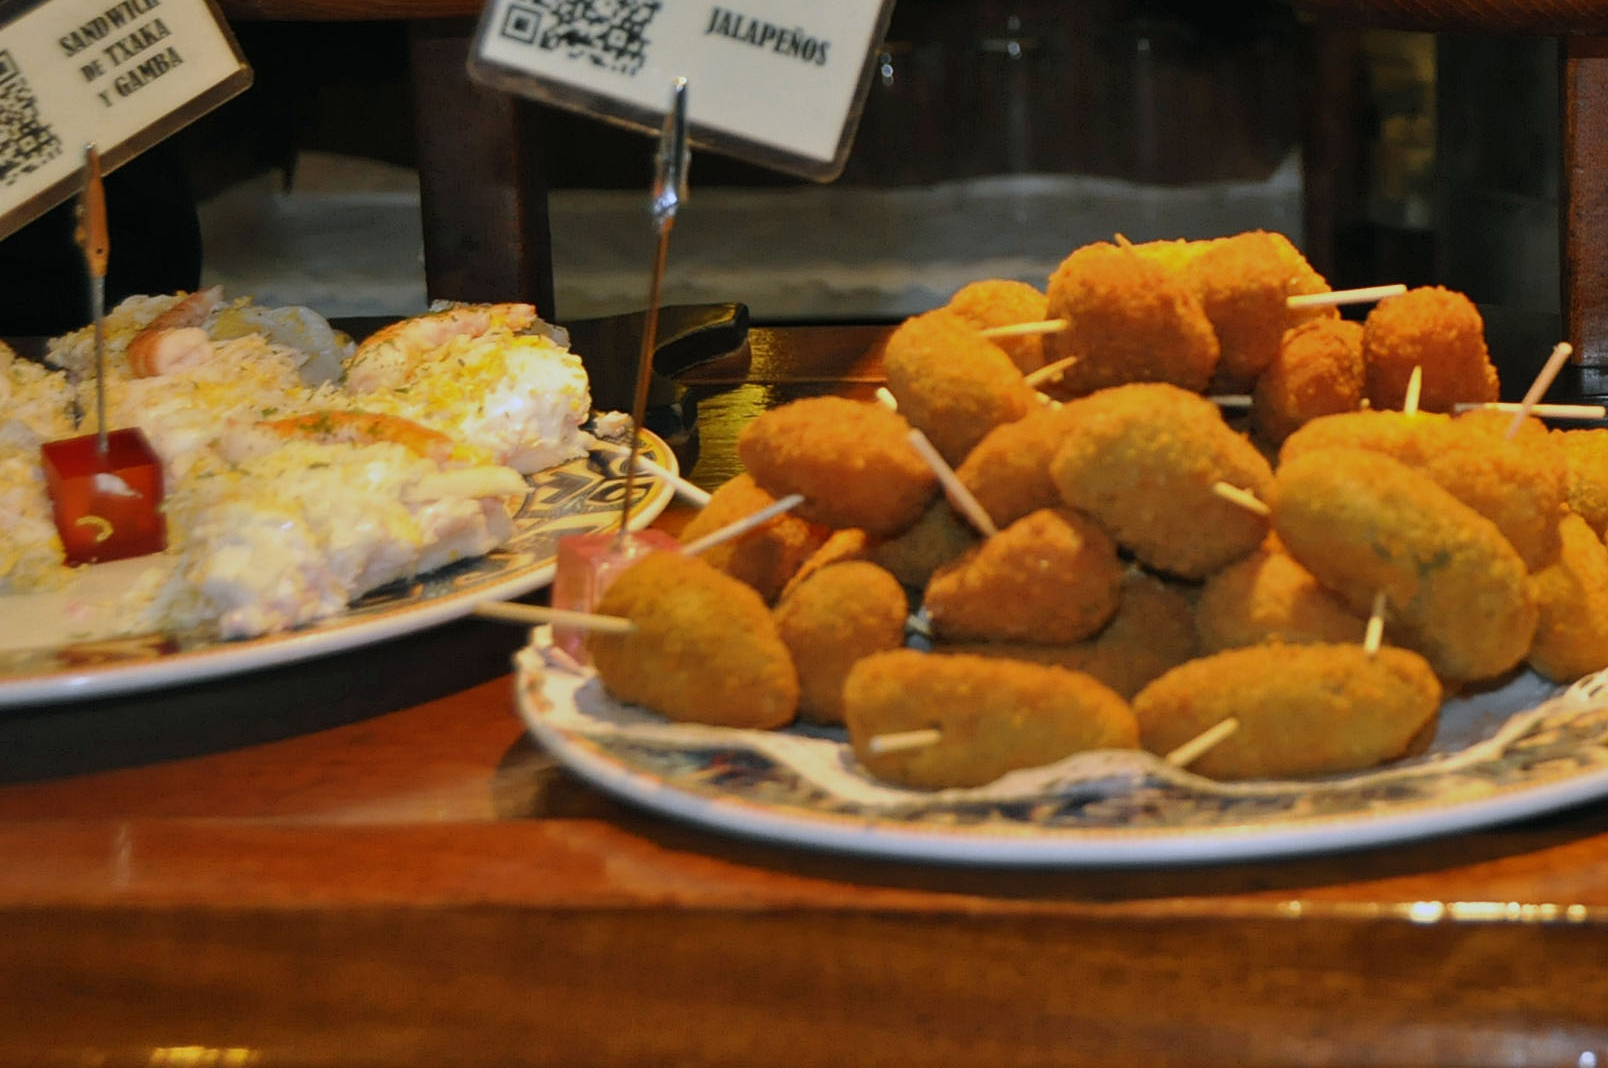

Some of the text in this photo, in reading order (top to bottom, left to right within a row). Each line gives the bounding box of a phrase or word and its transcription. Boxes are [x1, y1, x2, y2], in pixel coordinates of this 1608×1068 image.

[80, 17, 172, 83] DE TXAKA
[703, 4, 832, 67] JALAPEÑOS
[98, 45, 184, 108] Y GAMBA
